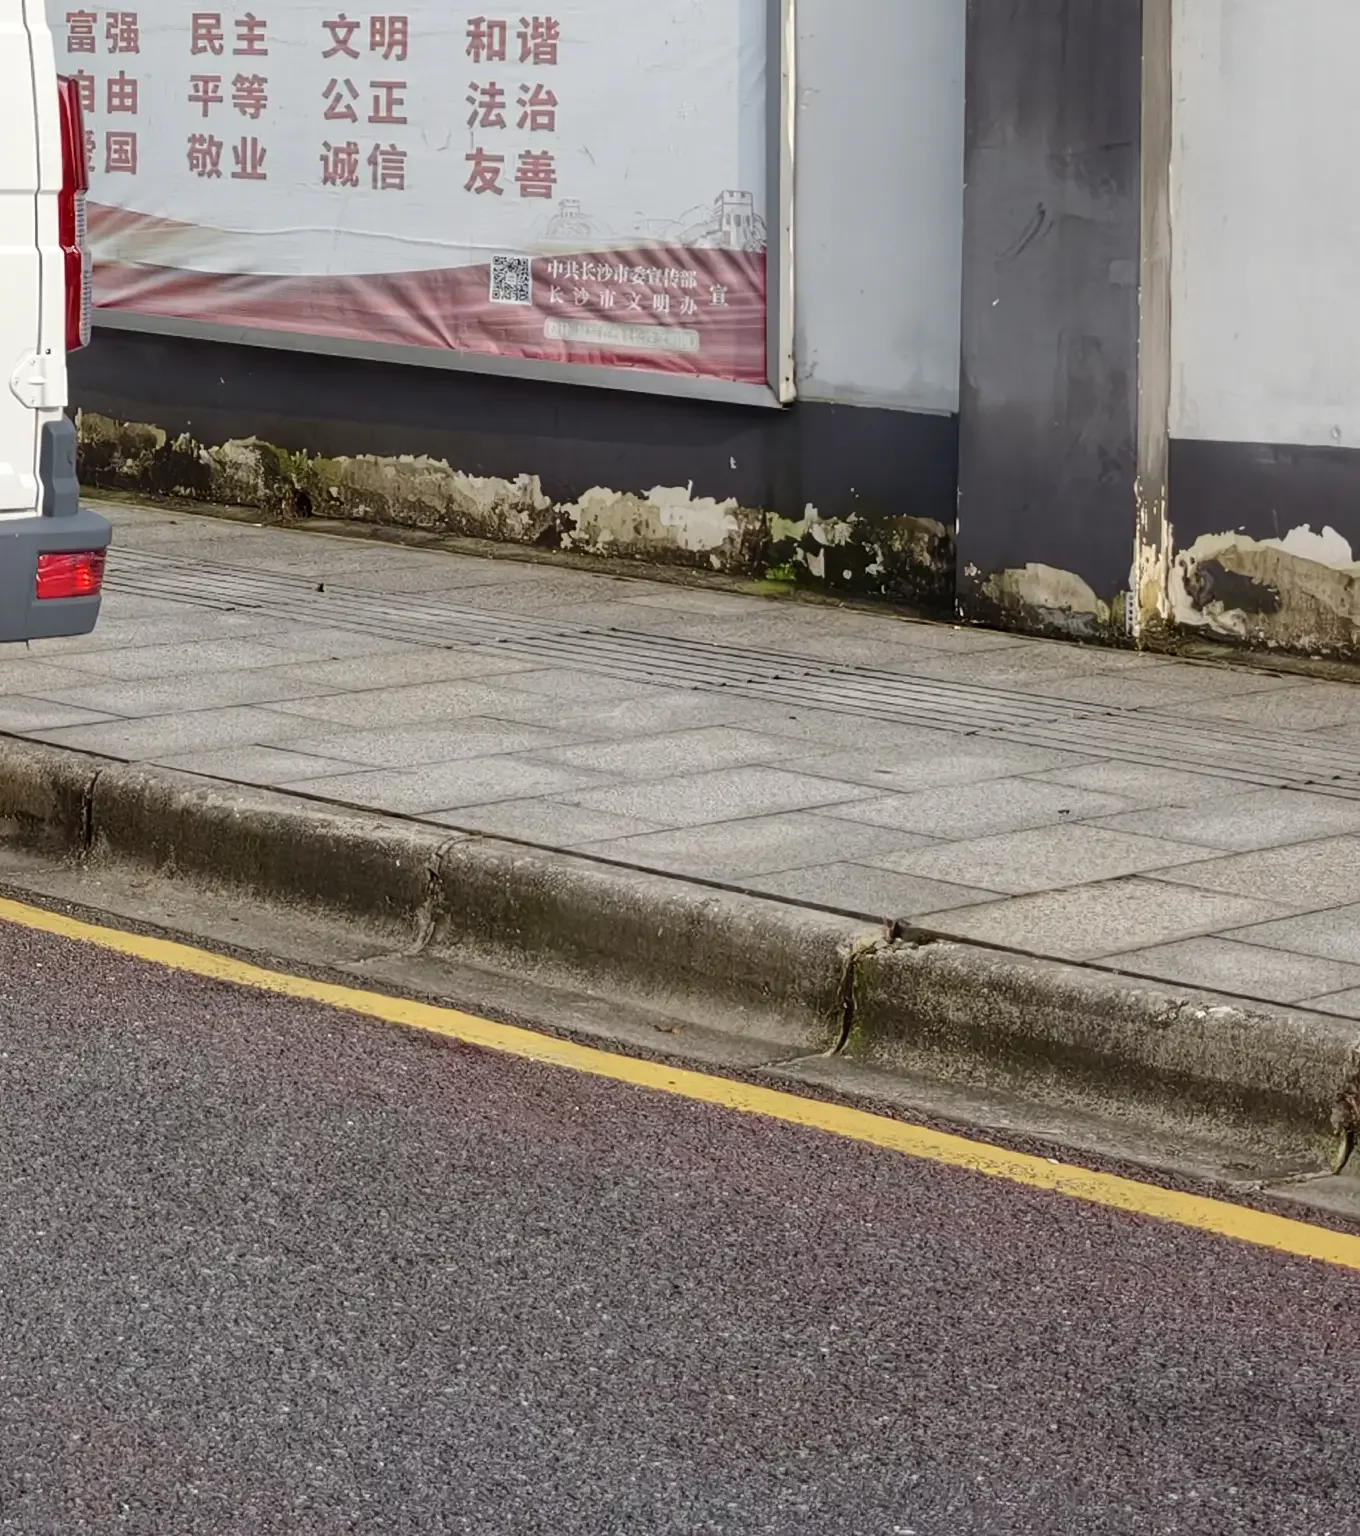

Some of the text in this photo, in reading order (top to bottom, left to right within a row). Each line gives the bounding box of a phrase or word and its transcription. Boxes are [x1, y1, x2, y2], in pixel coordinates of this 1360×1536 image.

[65, 10, 560, 65] 富强 民主 文明 和谐
[70, 69, 559, 132] 自由 平等 公正 法治
[187, 133, 267, 180] 敬业
[320, 140, 407, 190] 诚信
[463, 146, 557, 199] 友善
[547, 259, 697, 290] 中共长沙市委宣传部
[709, 284, 729, 306] 宣
[549, 285, 698, 316] 长沙市文明办
